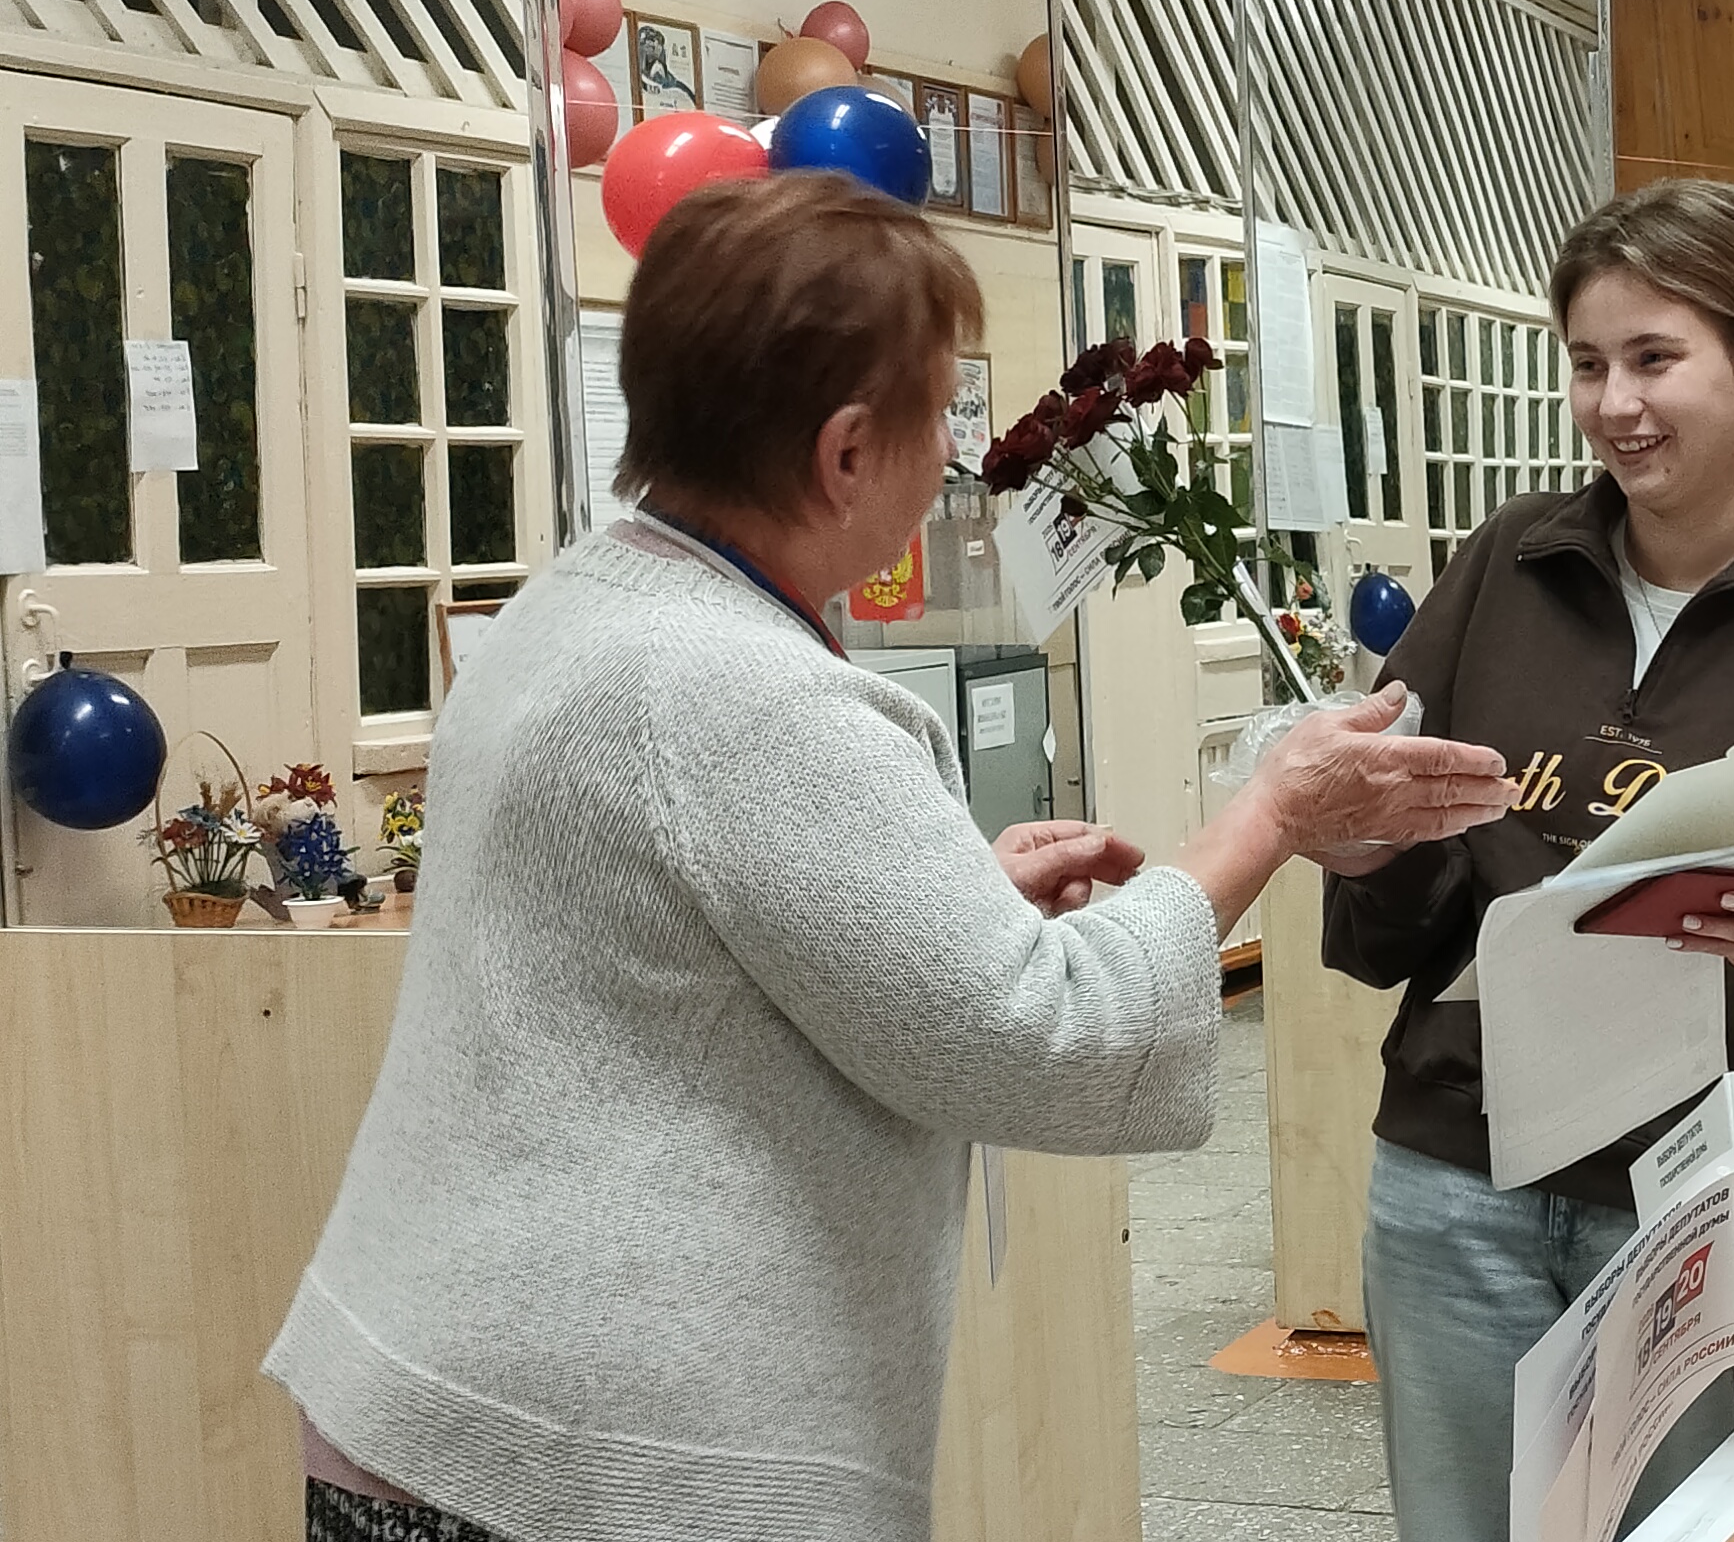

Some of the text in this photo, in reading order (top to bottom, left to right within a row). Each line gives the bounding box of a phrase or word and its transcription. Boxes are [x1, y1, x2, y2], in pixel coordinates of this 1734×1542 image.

[1051, 523, 1072, 562] 18 19
[1600, 725, 1623, 738] EST.
[1636, 1187, 1730, 1283] ВЫБОРЫ ДЕПУТАТОВ
[1699, 1210, 1730, 1237] ДУМЫ
[1584, 1259, 1625, 1315] ВЫБОРЫ
[1636, 1259, 1703, 1376] 18 19 20
[1653, 1312, 1701, 1365] СЕНТЯБРЯ
